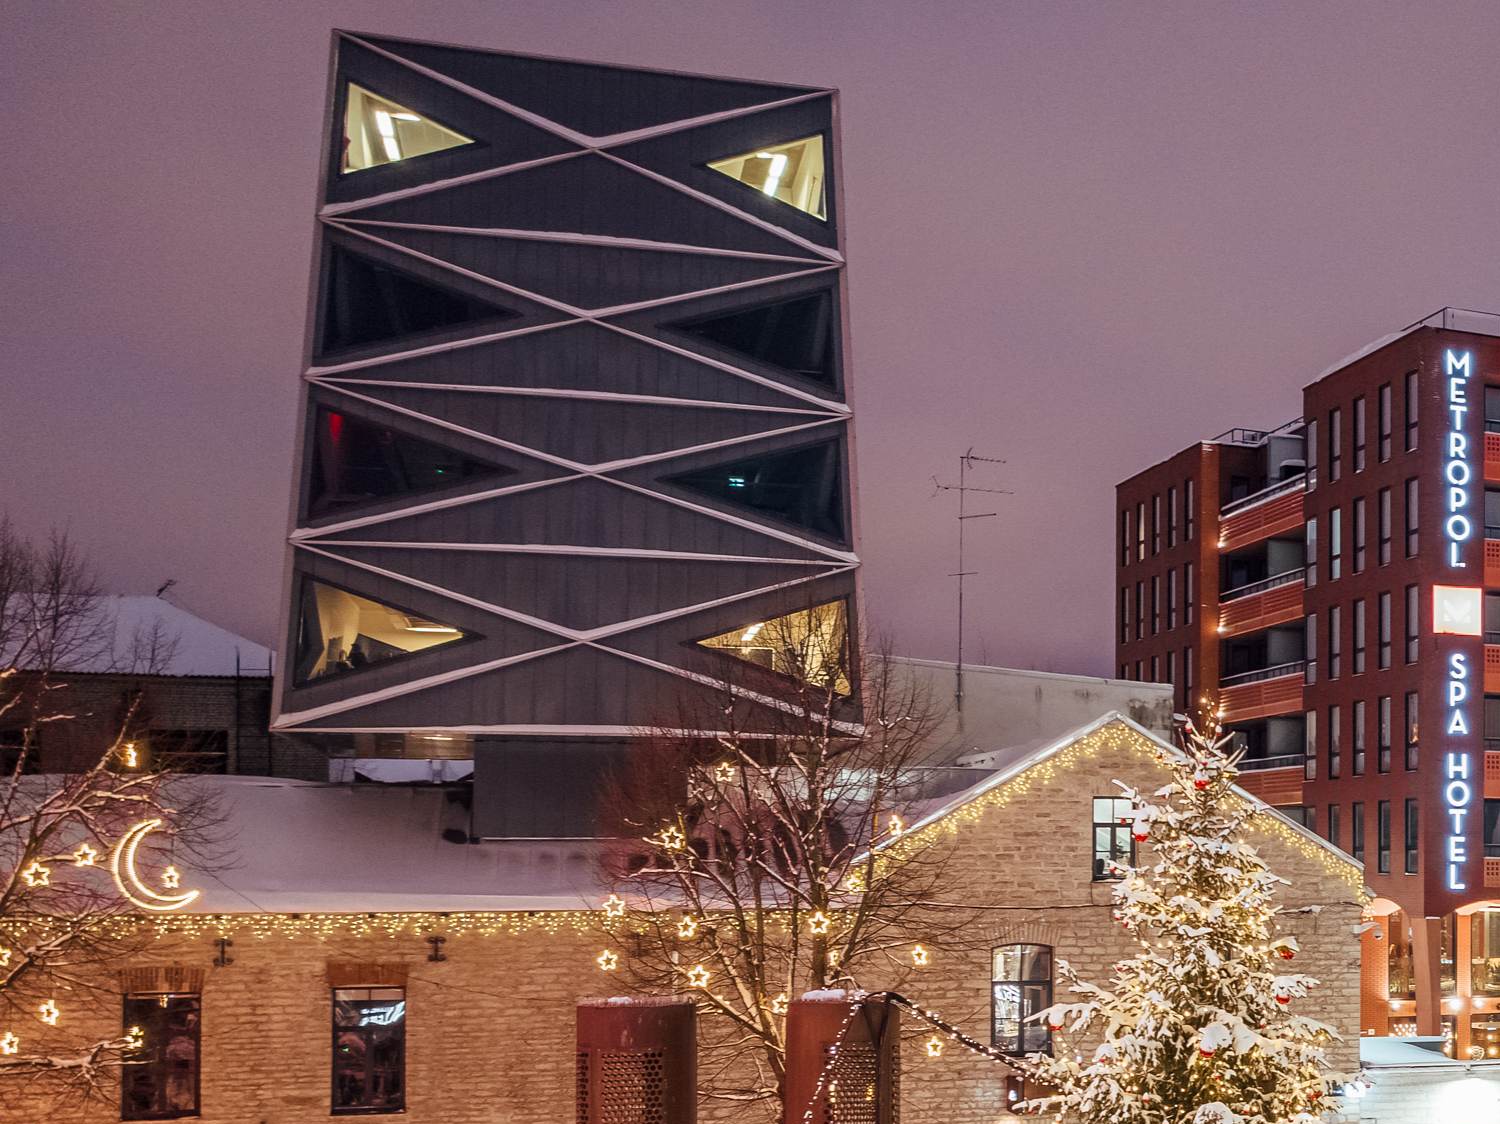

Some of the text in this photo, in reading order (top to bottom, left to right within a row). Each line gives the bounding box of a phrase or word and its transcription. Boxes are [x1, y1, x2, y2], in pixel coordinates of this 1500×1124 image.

[1445, 349, 1471, 568] METROPOL
[1445, 653, 1471, 890] SPA HOTEL
